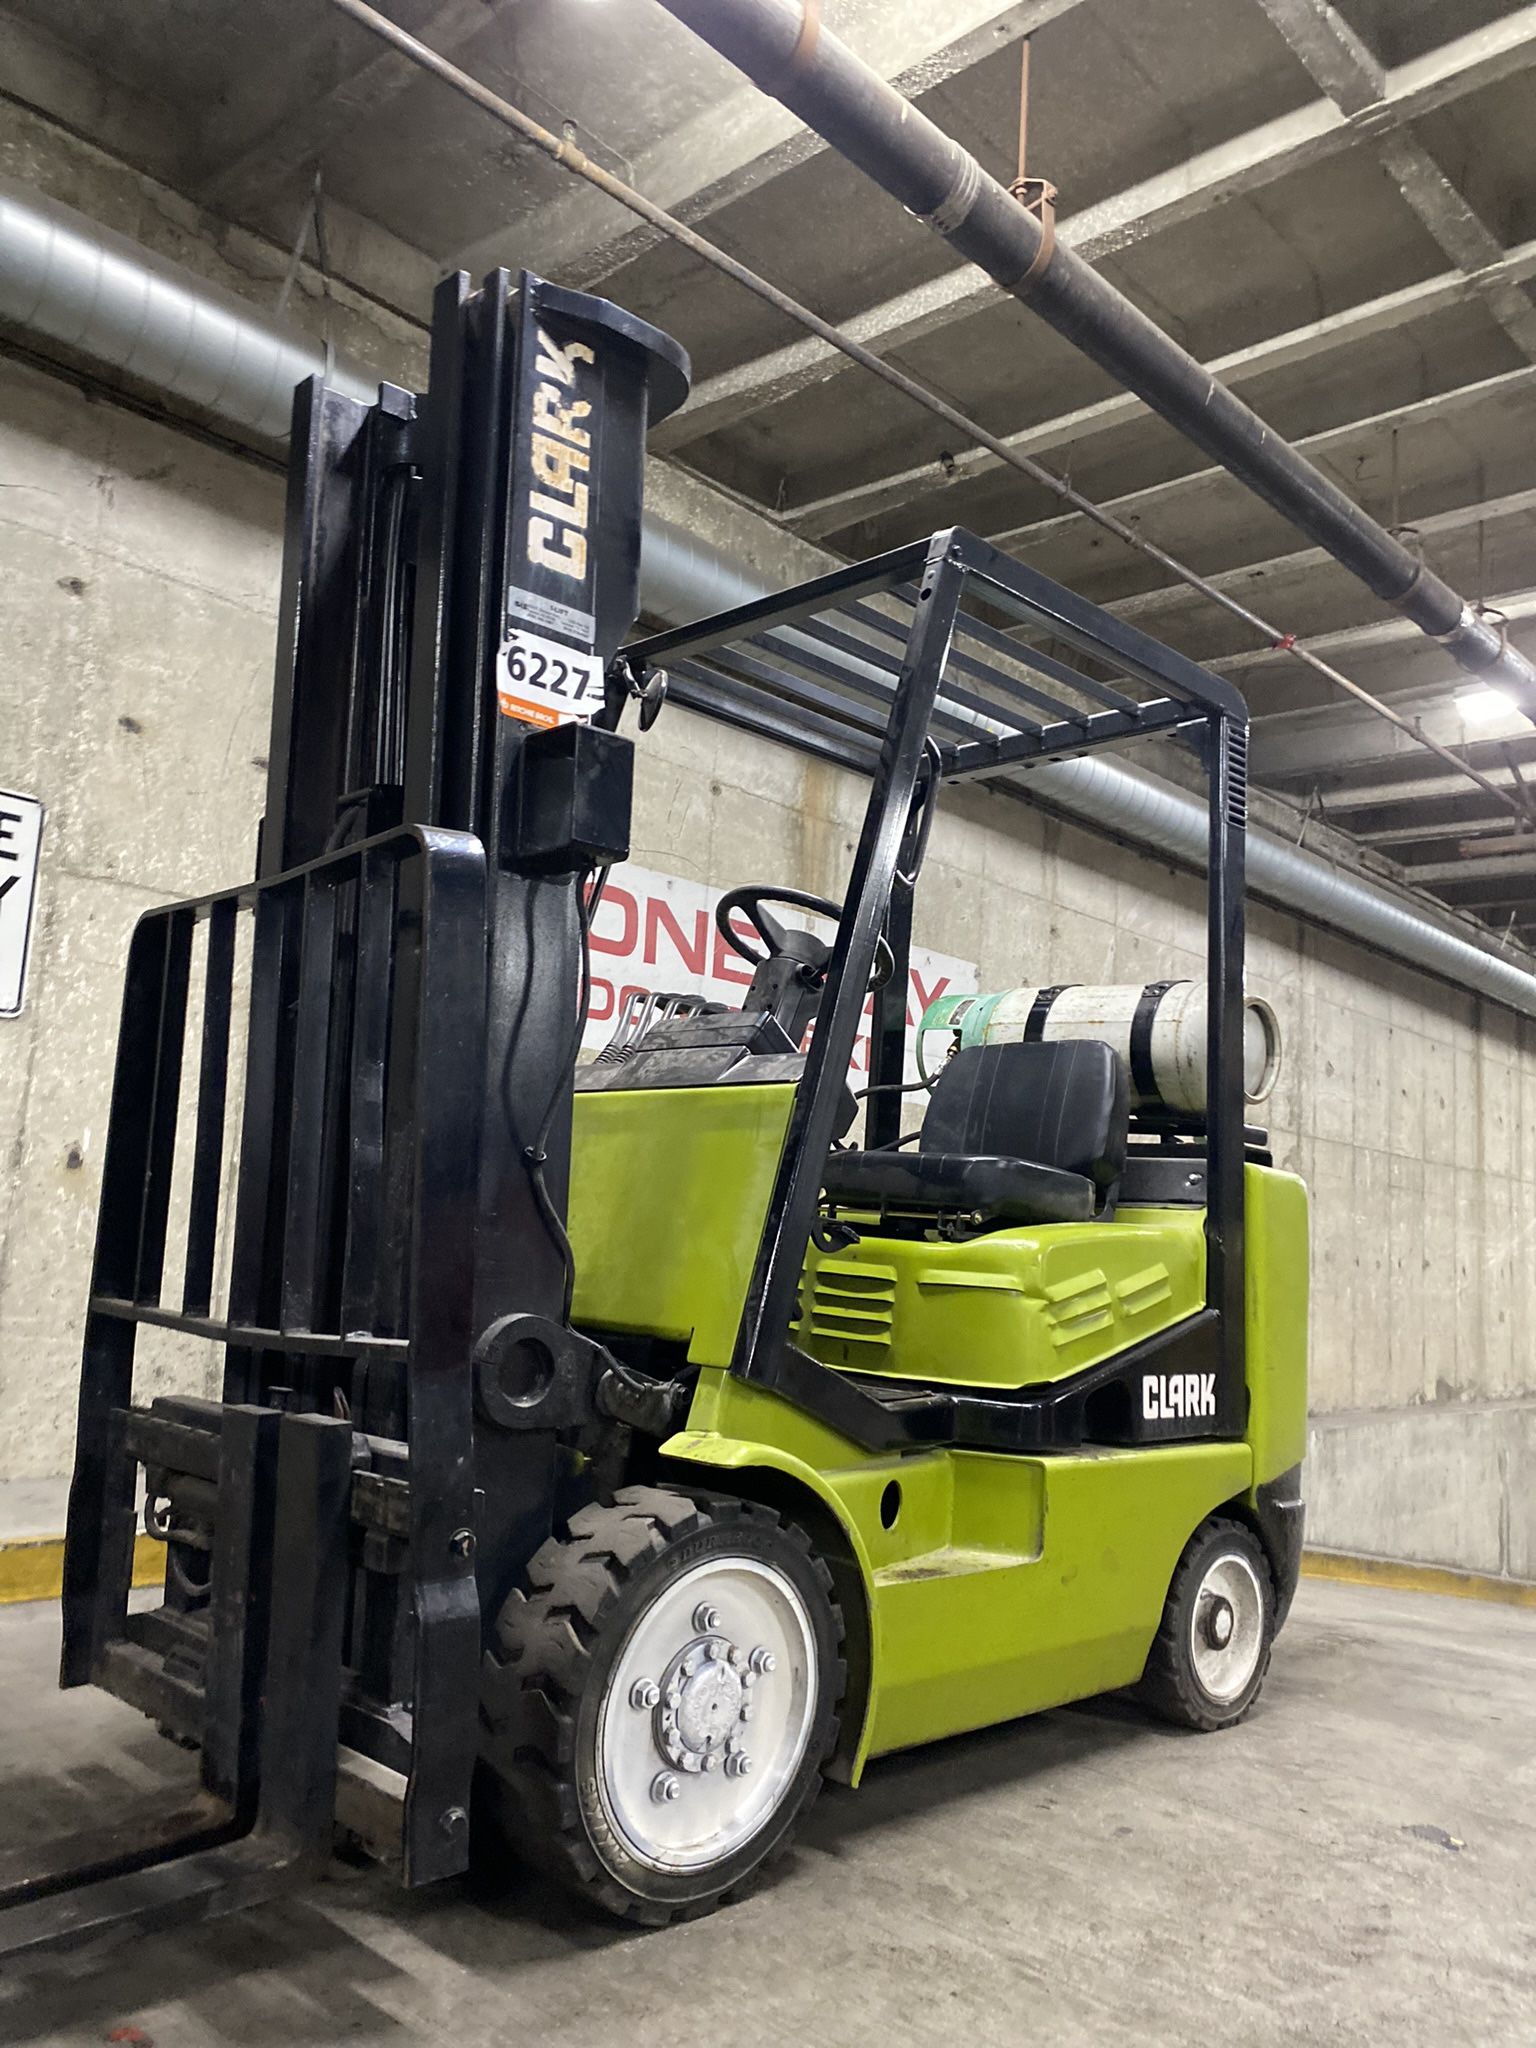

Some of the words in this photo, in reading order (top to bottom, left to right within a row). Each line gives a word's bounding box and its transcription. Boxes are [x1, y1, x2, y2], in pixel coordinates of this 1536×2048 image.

[527, 329, 595, 580] CLARK
[507, 645, 590, 700] 6227
[1142, 1373, 1216, 1420] CLARK
